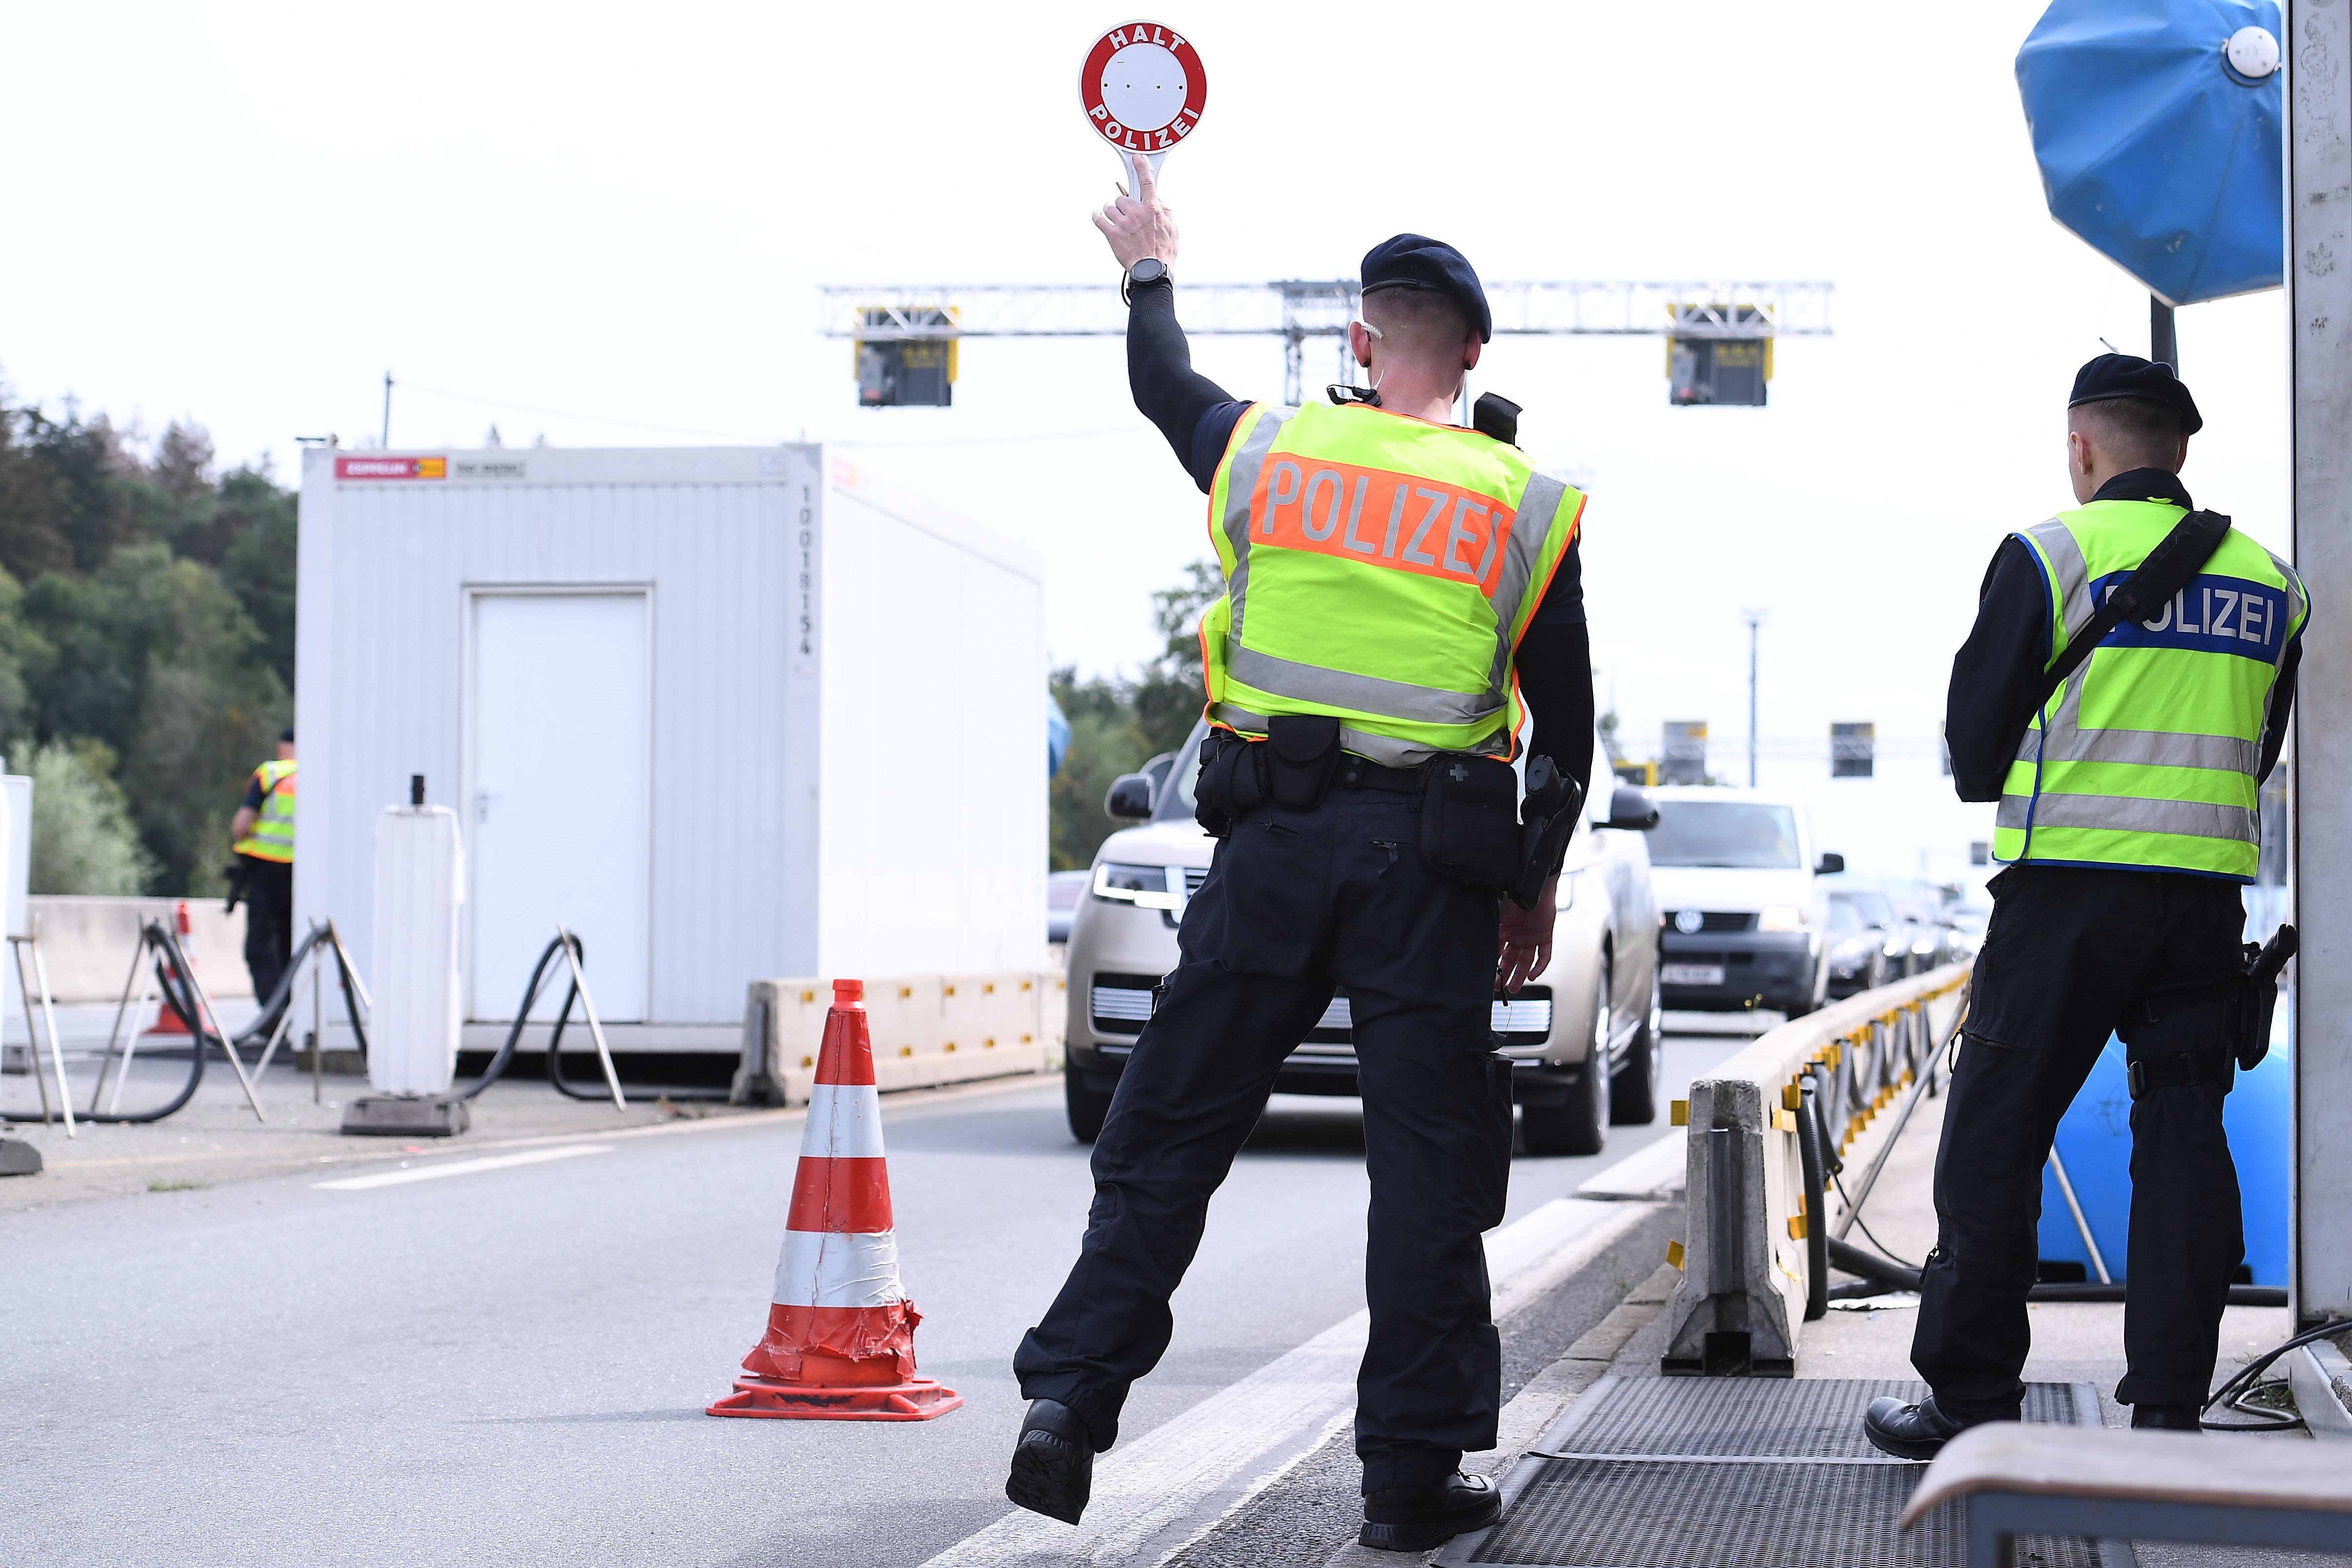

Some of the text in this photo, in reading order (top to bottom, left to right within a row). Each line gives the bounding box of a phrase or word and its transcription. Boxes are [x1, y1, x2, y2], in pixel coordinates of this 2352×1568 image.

[1108, 25, 1185, 52] HALT
[1089, 103, 1200, 150] POLIZEI
[1262, 461, 1504, 585] POLIZEI
[2105, 585, 2274, 646] OLIZEI
